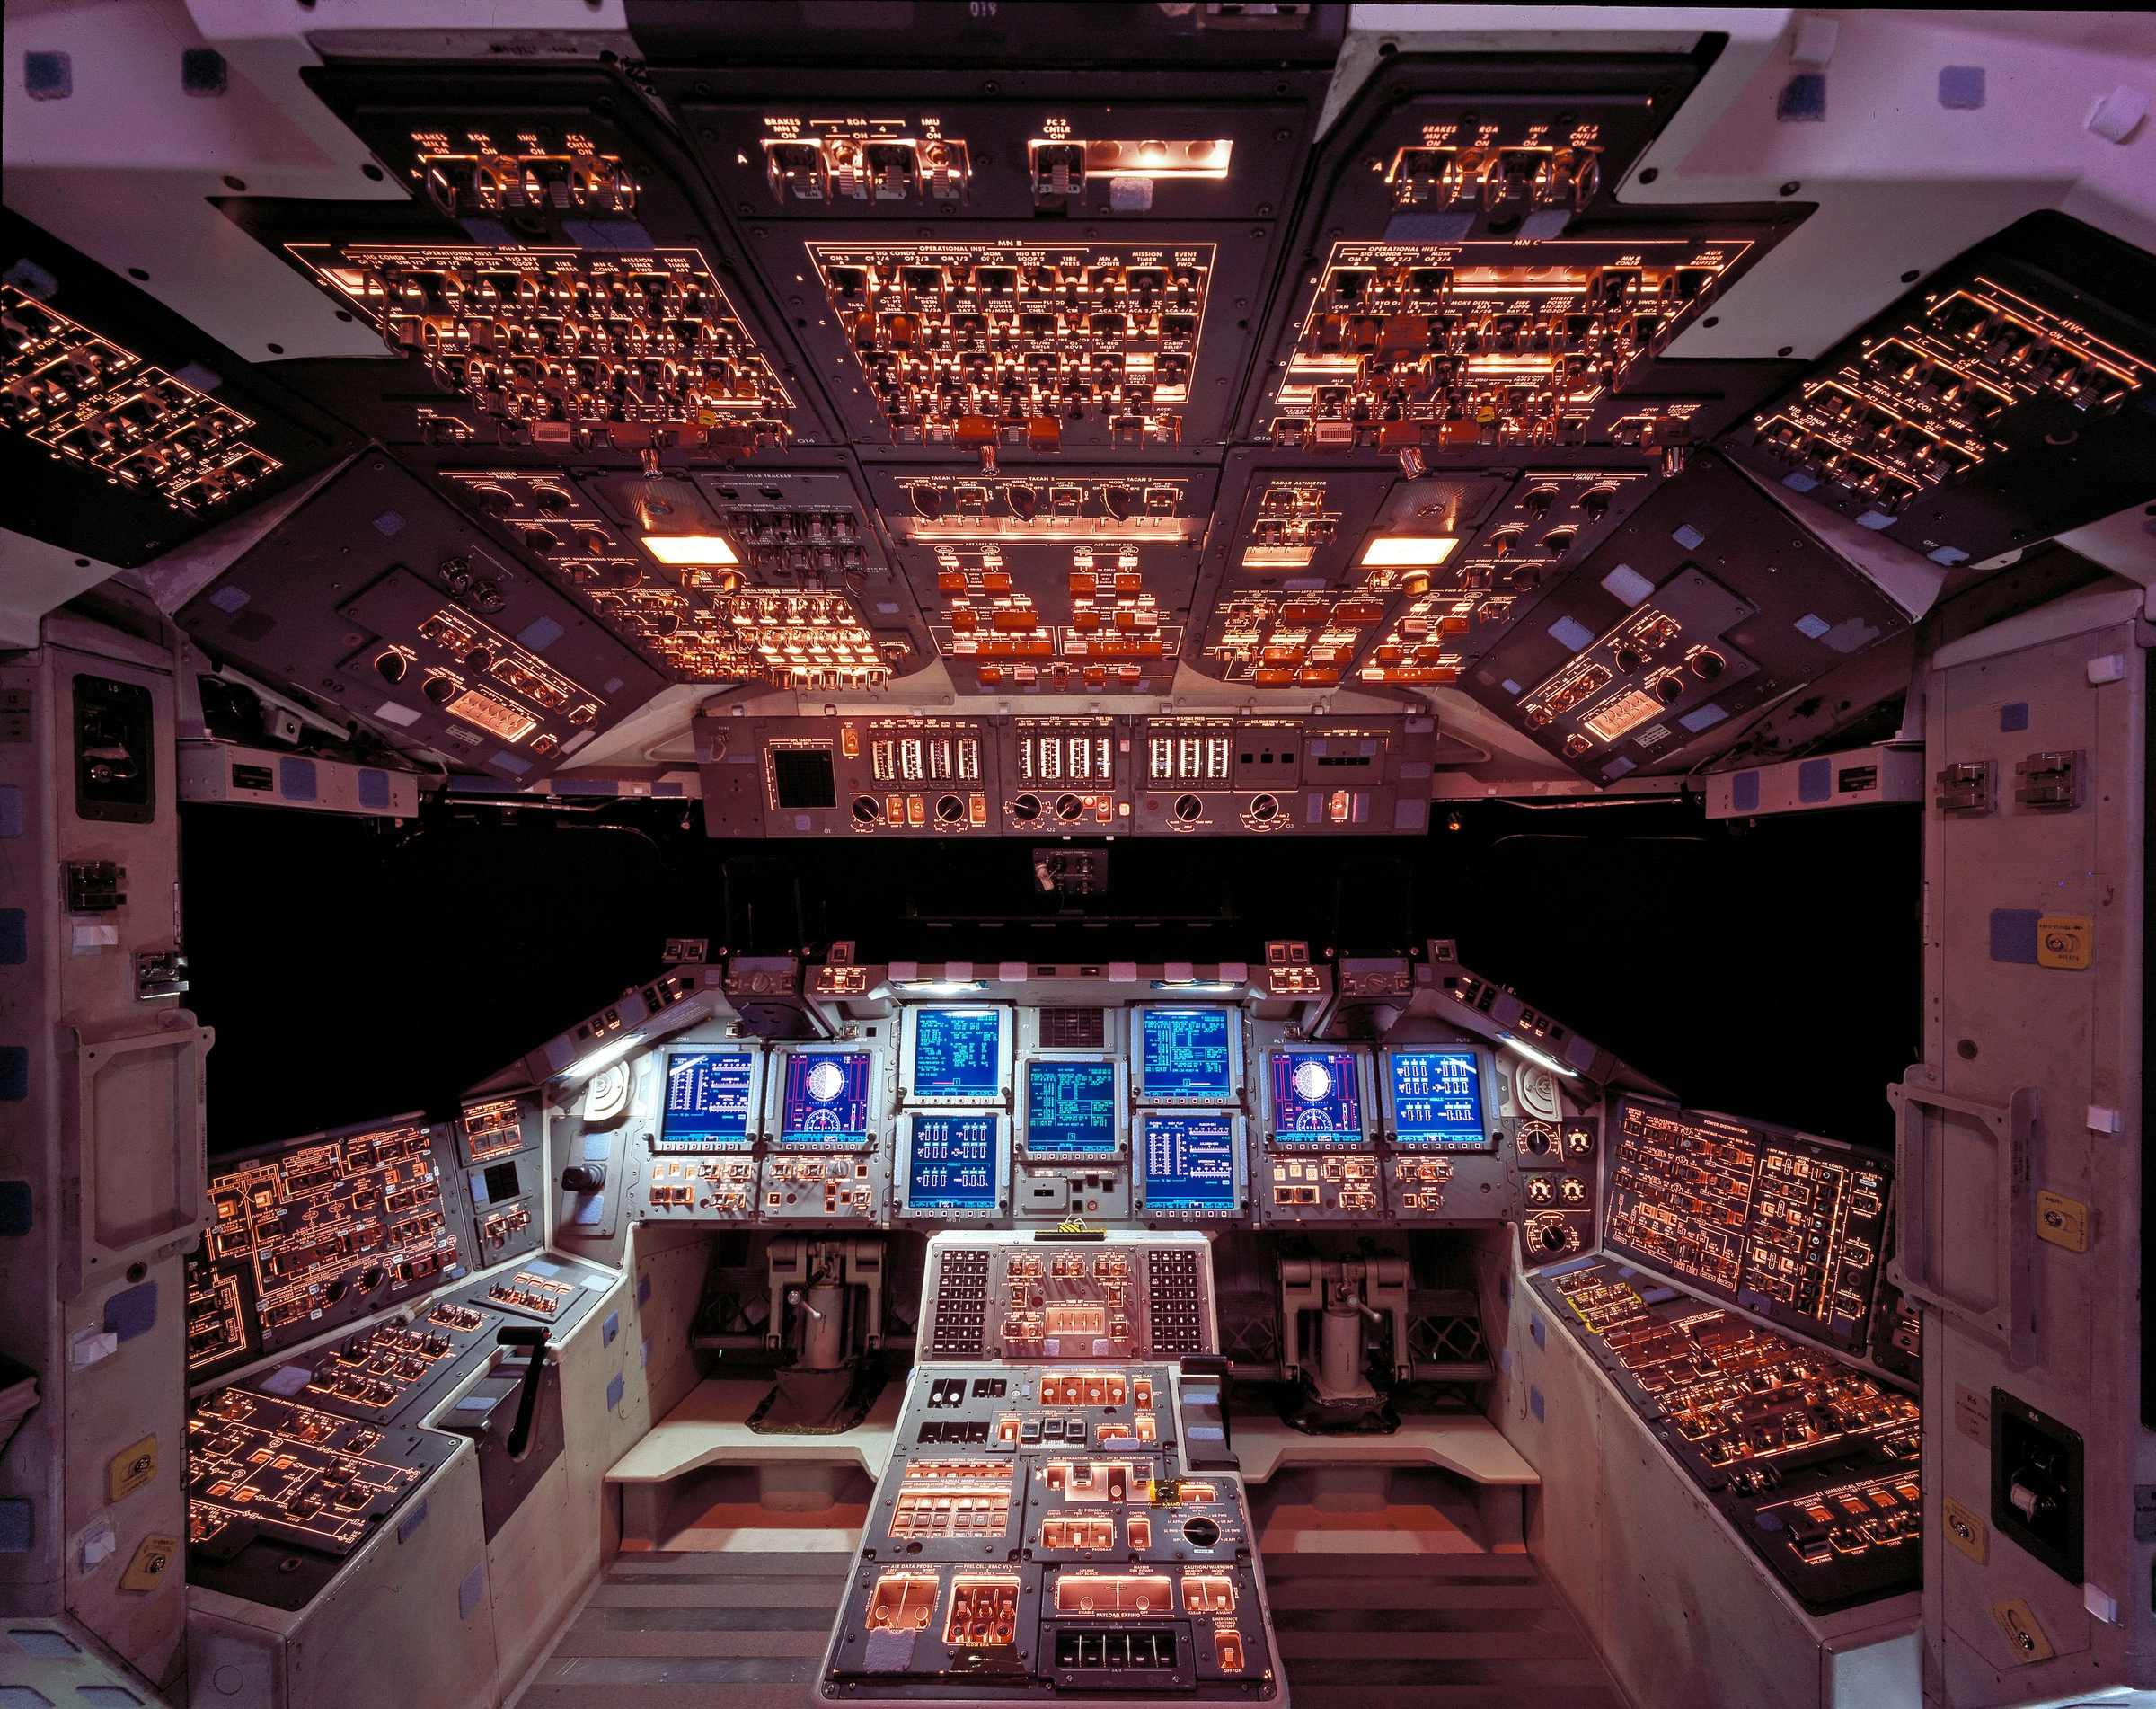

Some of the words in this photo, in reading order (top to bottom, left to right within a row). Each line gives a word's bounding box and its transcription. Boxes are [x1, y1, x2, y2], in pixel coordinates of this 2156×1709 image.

[2059, 320, 2084, 334] ATVC
[1871, 386, 1891, 397] FREON
[1720, 1124, 1748, 1134] DISTRIBUTION
[2029, 1412, 2039, 1422] R6
[1824, 1484, 1856, 1496] UMBILICAL
[1856, 1480, 1876, 1488] DOOR
[1793, 1497, 1821, 1507] CENTERLINE
